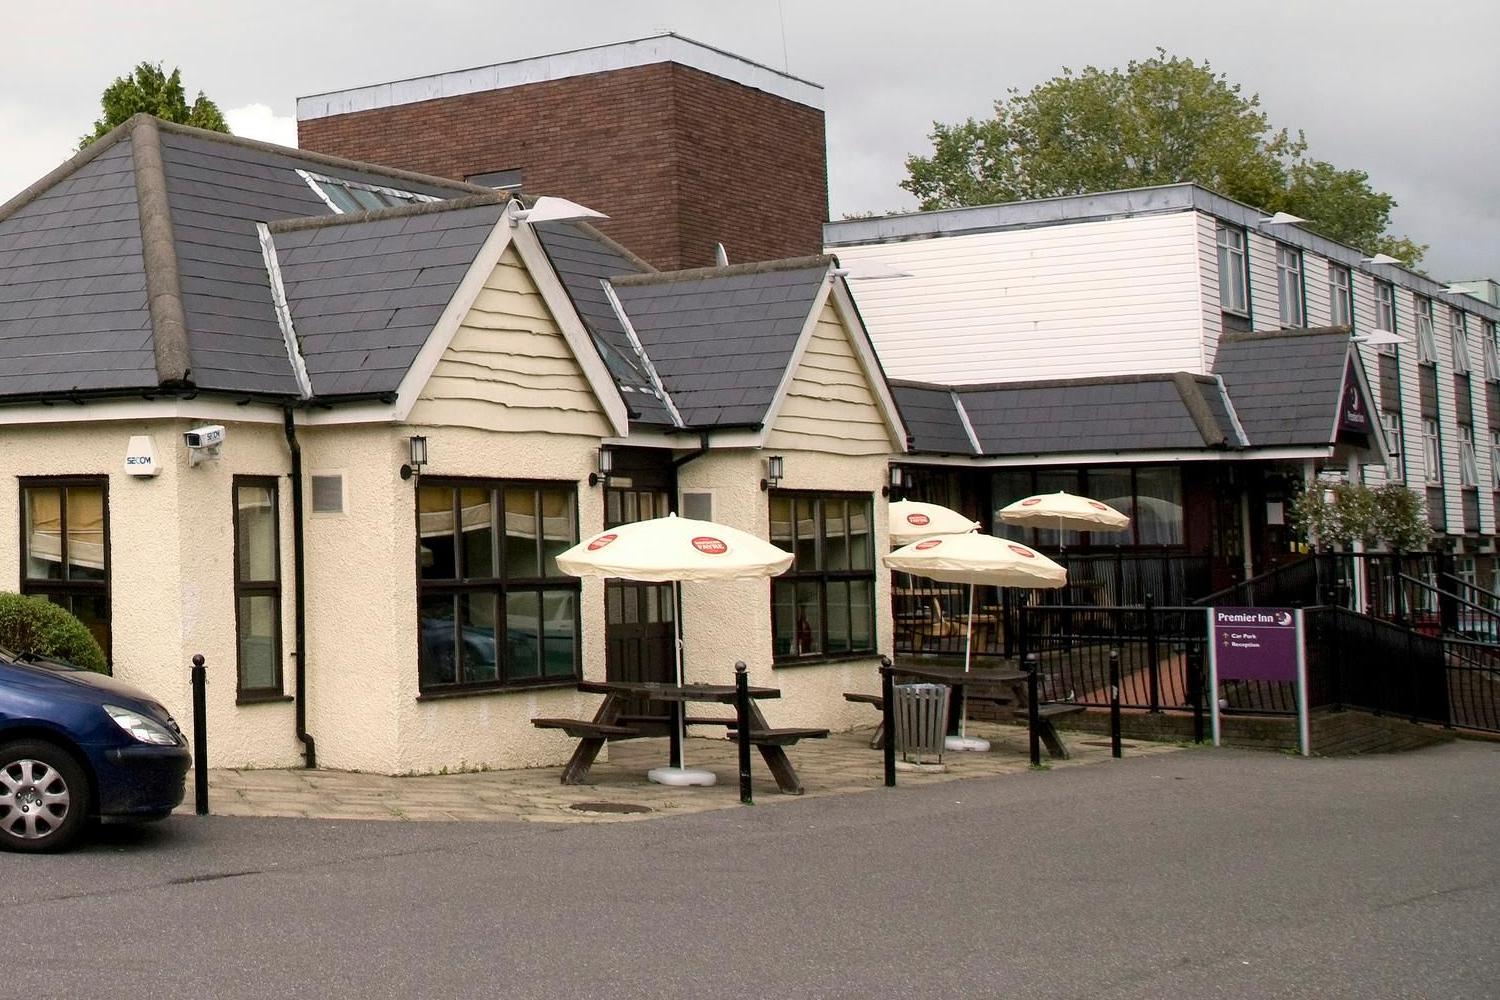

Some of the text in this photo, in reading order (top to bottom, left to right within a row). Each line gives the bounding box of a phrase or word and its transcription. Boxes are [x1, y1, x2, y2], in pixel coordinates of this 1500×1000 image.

[126, 456, 152, 465] SECOM
[1218, 612, 1274, 622] Premier Inn
